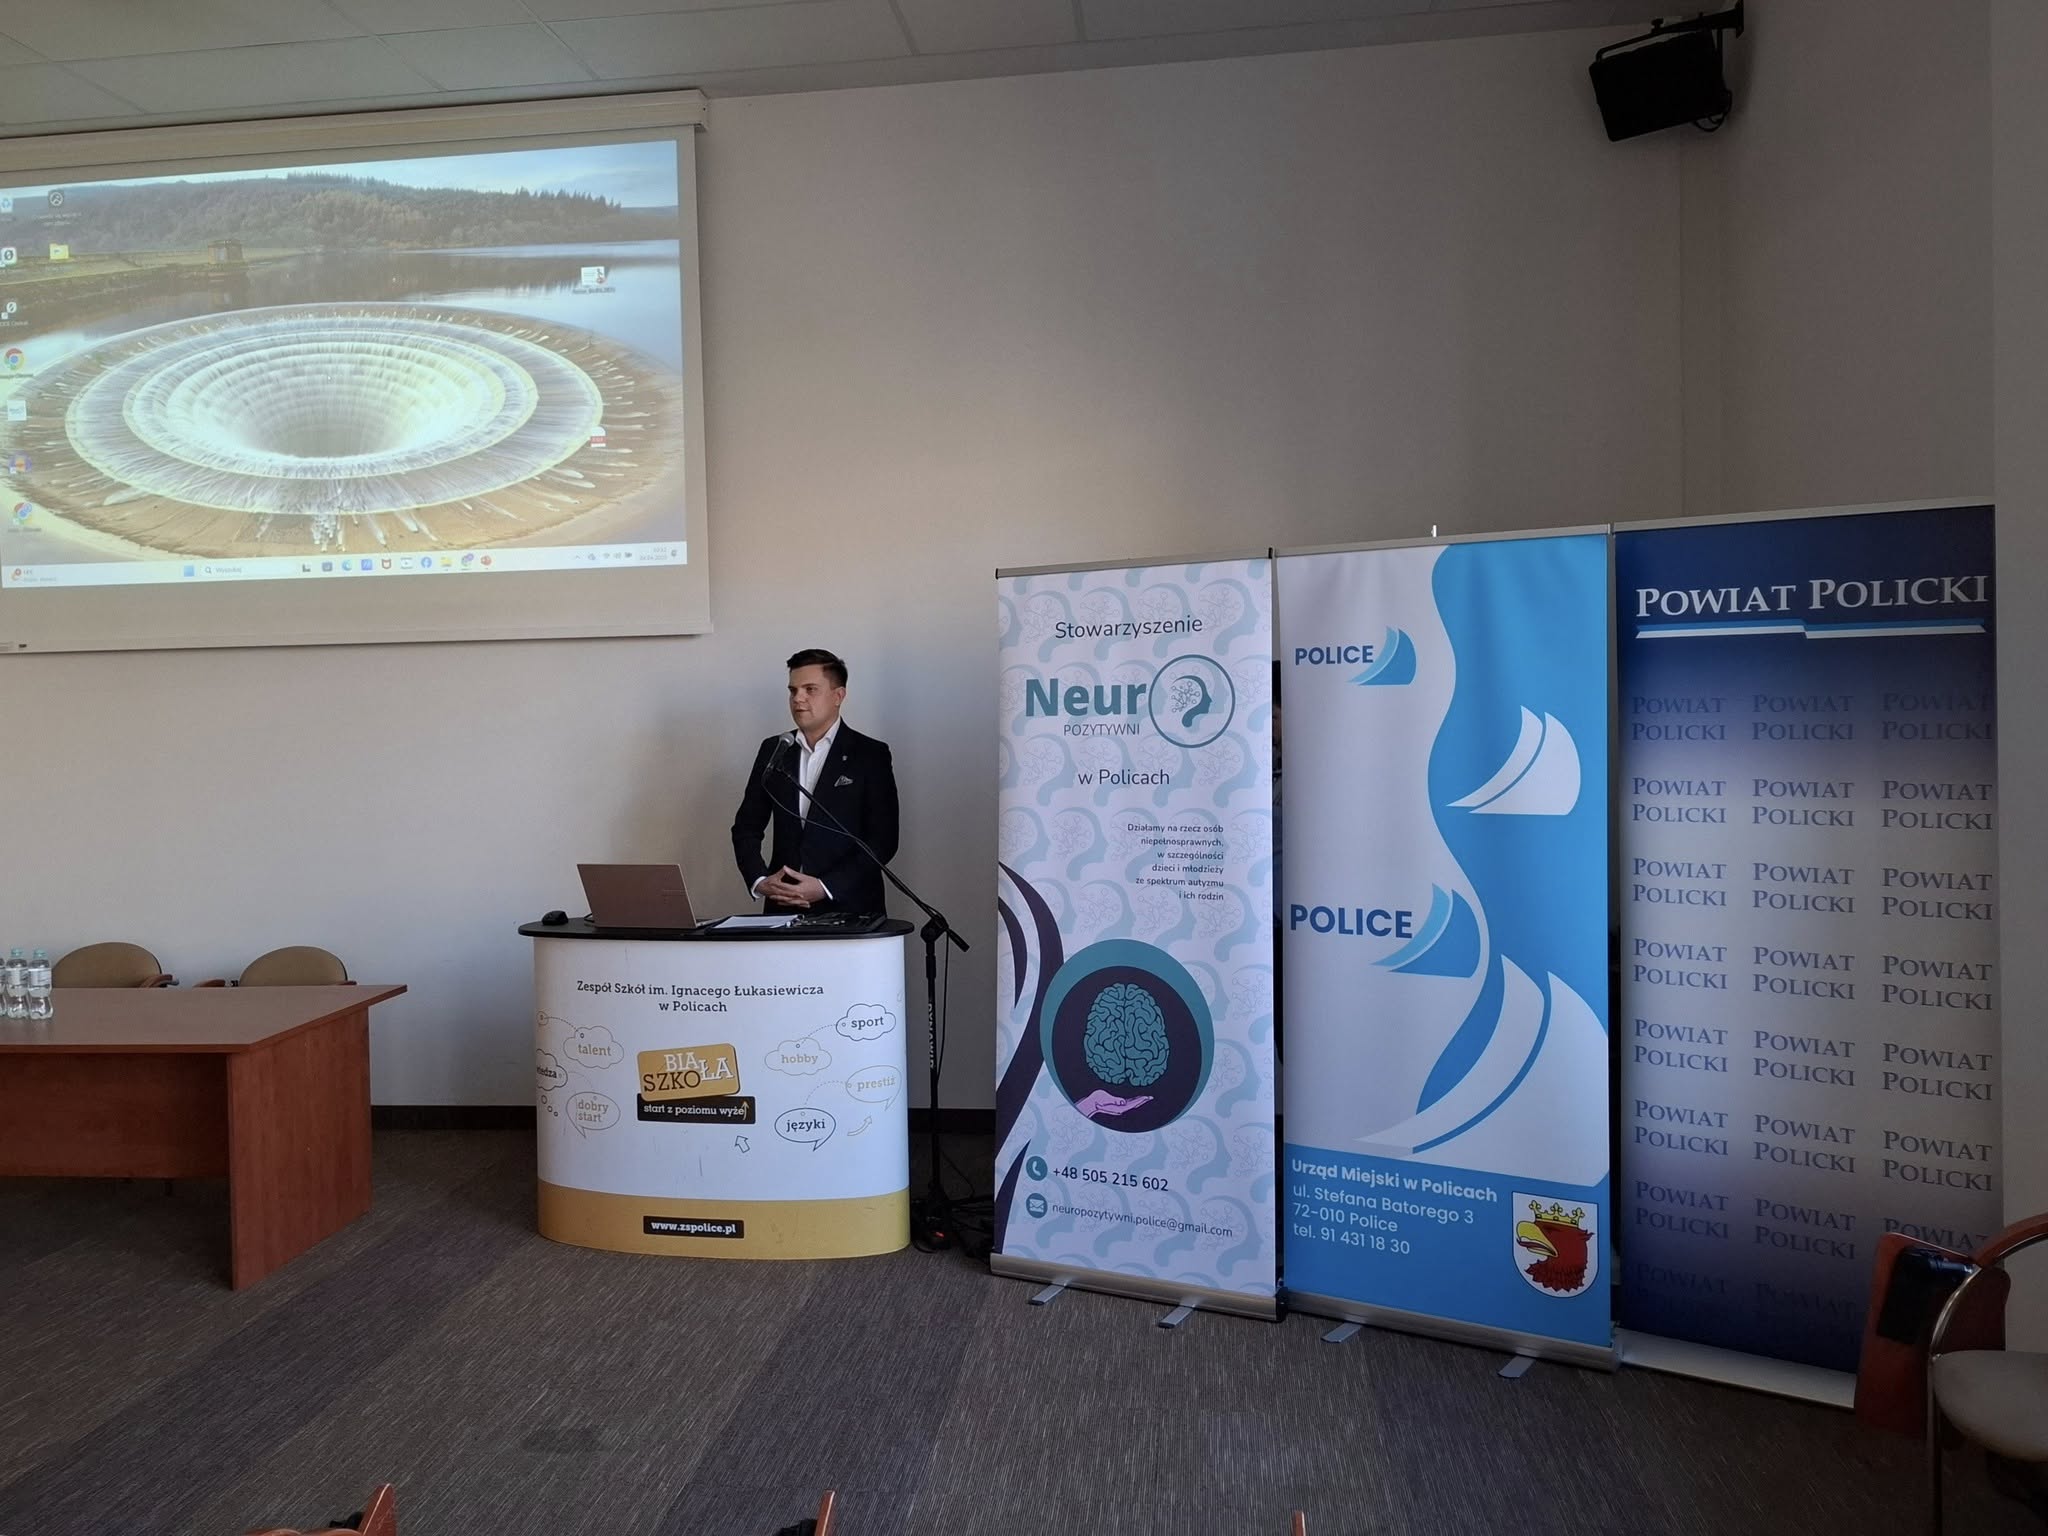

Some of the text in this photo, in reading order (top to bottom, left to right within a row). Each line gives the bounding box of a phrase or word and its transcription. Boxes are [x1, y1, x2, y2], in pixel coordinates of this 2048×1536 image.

[1636, 575, 1989, 617] POWIAT POLICKI
[1055, 615, 1203, 639] Stowarzyszenie
[1295, 645, 1374, 666] POLICE
[1632, 696, 1727, 714] POWIAT
[1752, 694, 1854, 713] POWIAT
[1063, 723, 1140, 737] POZYTYWNI
[1632, 722, 1727, 741] POLICKI
[1752, 722, 1854, 740] POLICKI
[1881, 720, 1992, 741] POLICKI
[1078, 769, 1170, 785] w Policach
[1632, 777, 1726, 797] POWIAT
[1752, 778, 1854, 799] POWIAT
[1881, 779, 1992, 800] POWIAT
[1632, 804, 1726, 824] POLICKI
[1752, 806, 1854, 827] POLICKI
[1881, 808, 1992, 830] POLICKI
[1127, 823, 1165, 833] Działamy
[1203, 825, 1224, 833] osób
[1140, 837, 1224, 847] niepełnosprawnych,
[1167, 851, 1224, 861] szczególności
[1152, 864, 1175, 872] dzieci
[1182, 865, 1224, 875] młodzieży
[1633, 857, 1727, 879] POWIAT
[1753, 862, 1854, 885] POWIAT
[1881, 867, 1992, 891] POWIAT
[1135, 877, 1224, 888] ze spektrum autyzmu
[1183, 891, 1195, 899] ich
[1198, 892, 1224, 900] rodzin
[1633, 884, 1727, 906] POLICKI
[1753, 890, 1854, 913] POLICKI
[1881, 896, 1992, 920] POLICKI
[1290, 903, 1413, 939] POLICE
[1634, 938, 1727, 962] POWIAT
[1753, 946, 1854, 971] POWIAT
[1634, 965, 1728, 989] POLICKI
[1882, 955, 1992, 981] POWIAT
[577, 980, 824, 998] Zespół Szkół im. Ignacego Łukasiewicza
[1753, 974, 1855, 1000] POLICKI
[1882, 984, 1992, 1010] POLICKI
[659, 1001, 727, 1012] w Policach
[851, 1016, 885, 1030] sport
[1634, 1019, 1728, 1045] POWIAT
[578, 1044, 611, 1056] talent
[1754, 1030, 1855, 1058] POWIAT
[781, 1054, 818, 1065] hobby
[1634, 1045, 1728, 1072] POLICKI
[1883, 1042, 1992, 1071] POWIAT
[1754, 1057, 1855, 1087] POLICKI
[857, 1075, 896, 1092] prestiż
[1883, 1071, 1992, 1101] POLICKI
[578, 1099, 609, 1114] dobry
[578, 1112, 602, 1122] start
[643, 1104, 665, 1113] start
[675, 1105, 717, 1116] poziomu
[1635, 1099, 1728, 1128] POWIAT
[786, 1118, 826, 1132] języki
[1755, 1114, 1855, 1144] POWIAT
[1635, 1126, 1729, 1155] POLICKI
[1883, 1130, 1992, 1161] POWIAT
[1755, 1141, 1855, 1173] POLICKI
[1053, 1166, 1169, 1191] +48 505 215 602
[1292, 1159, 1497, 1202] Urząd Miejski w Policach
[1883, 1159, 1992, 1192] POLICKI
[1293, 1184, 1474, 1224] ul. Stefana Batorego 3
[650, 1220, 737, 1235] www.zspolice.pl
[1052, 1204, 1233, 1238] neuropozytywni.police@gmail.com
[1293, 1203, 1398, 1232] 72-010 Police
[1635, 1207, 1729, 1239] POLICKI
[1293, 1222, 1410, 1255] tel. 91 431 18 30
[1755, 1226, 1855, 1259] POLICKI
